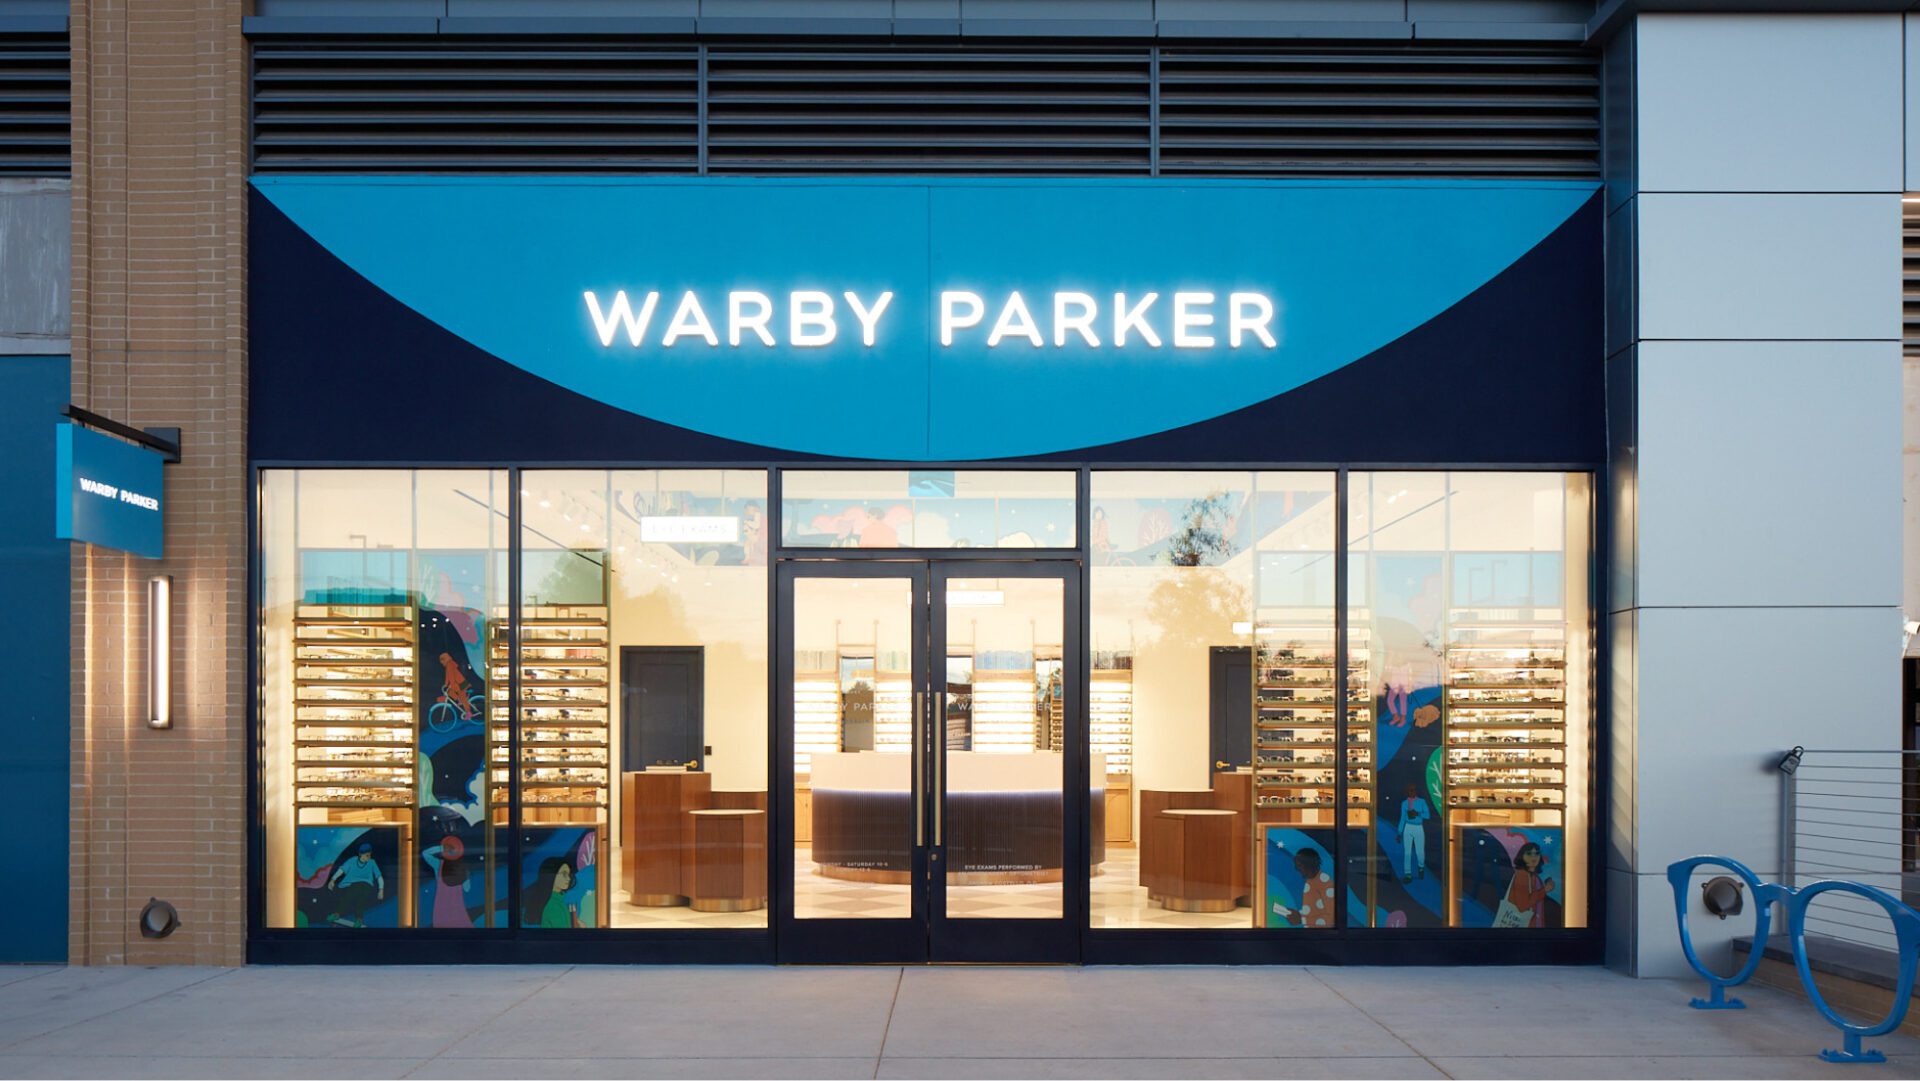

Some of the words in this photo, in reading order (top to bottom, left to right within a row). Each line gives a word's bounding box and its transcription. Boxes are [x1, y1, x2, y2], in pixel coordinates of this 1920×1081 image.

[583, 290, 894, 347] WARBY
[939, 290, 1278, 348] PARKER
[80, 478, 118, 499] WARBY
[120, 490, 159, 511] PARKER
